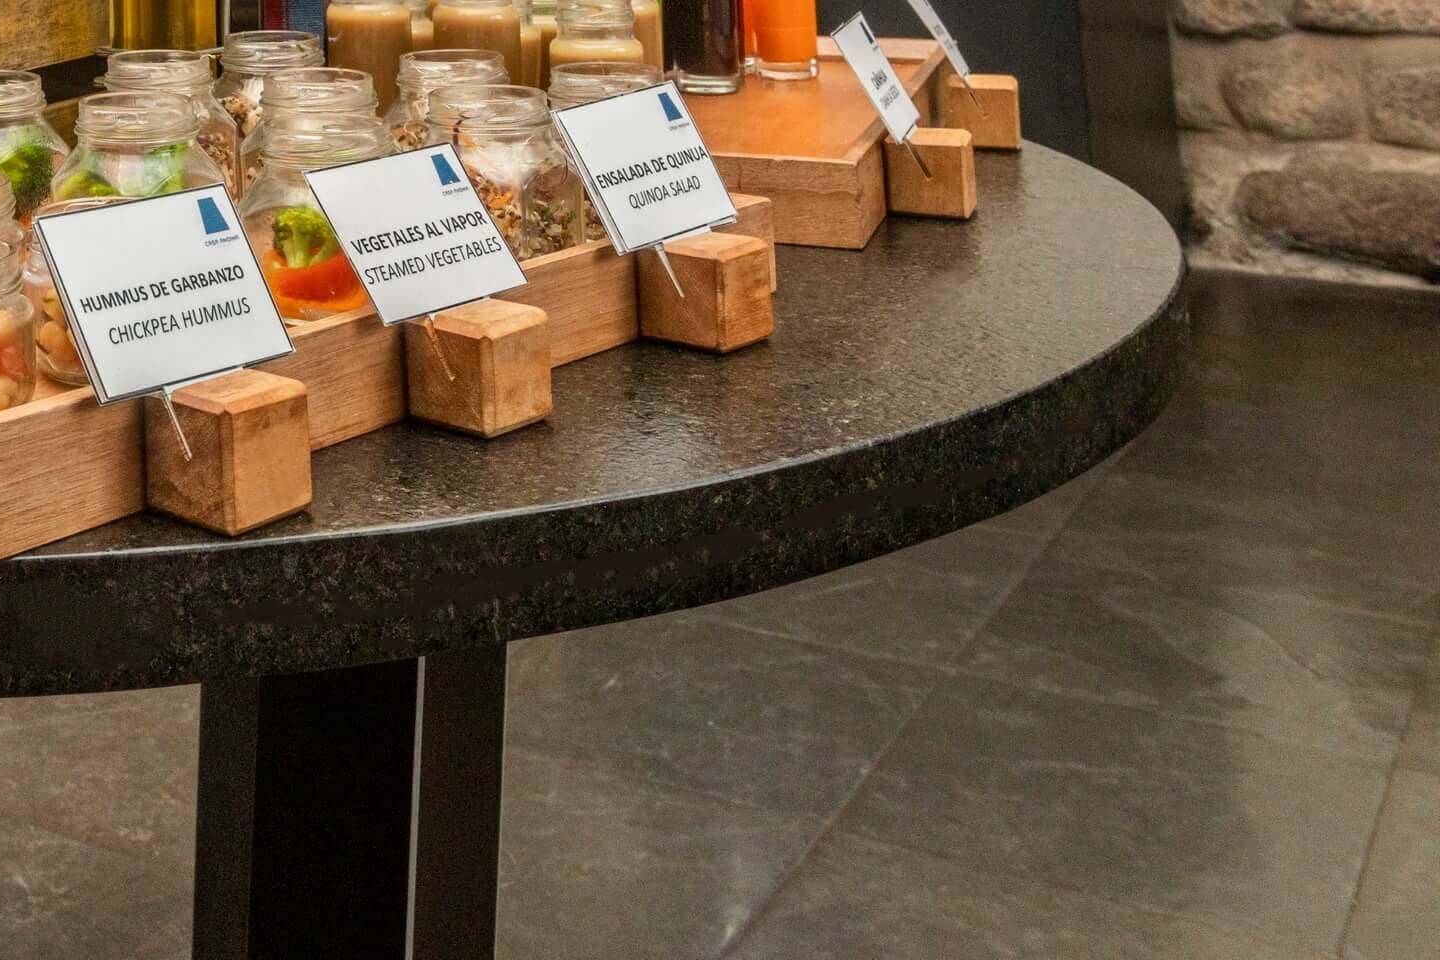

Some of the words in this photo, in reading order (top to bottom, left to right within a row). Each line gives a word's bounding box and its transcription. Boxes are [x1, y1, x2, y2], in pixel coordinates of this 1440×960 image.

[596, 162, 653, 189] ENSALADA
[652, 157, 668, 173] DE
[667, 146, 708, 169] QUINUA
[629, 185, 671, 209] QUINOA
[670, 176, 701, 197] SALAD
[350, 225, 424, 256] VEGETALES
[426, 222, 444, 239] AL
[441, 211, 488, 235] VAPOR
[365, 256, 425, 286] STEAMED
[426, 236, 502, 269] VEGETABLES
[80, 286, 150, 315] HUMMUS
[150, 282, 171, 299] DE
[172, 265, 246, 294] GARBANZO
[108, 314, 181, 345] CHICKPEA
[184, 298, 251, 329] HUMMUS
